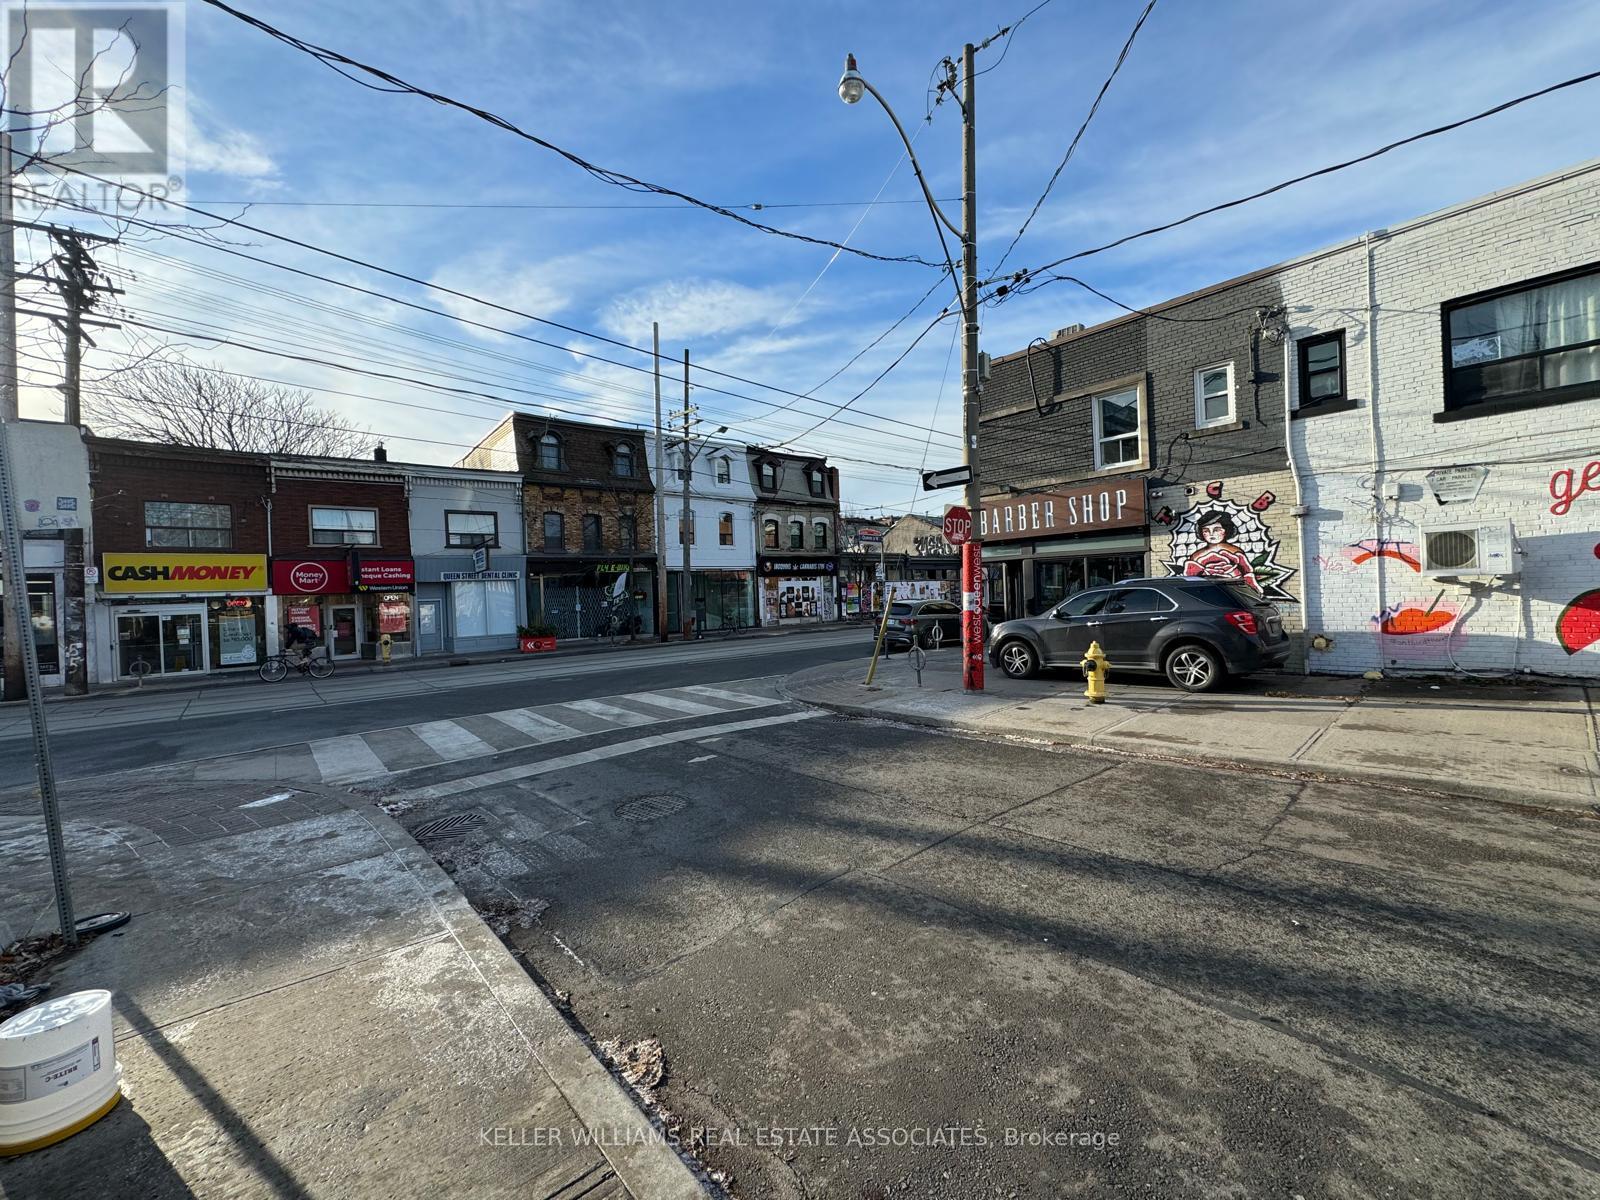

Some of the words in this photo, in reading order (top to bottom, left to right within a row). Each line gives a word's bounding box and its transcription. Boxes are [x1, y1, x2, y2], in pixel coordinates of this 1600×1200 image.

[981, 500, 1055, 536] BARBER
[1069, 489, 1127, 525] SHOP
[945, 517, 971, 534] STOP
[295, 571, 324, 580] Money
[443, 572, 460, 580] QUEEN
[461, 572, 480, 580] STREET
[481, 571, 500, 579] DENTAL
[501, 571, 518, 579] CLINIC
